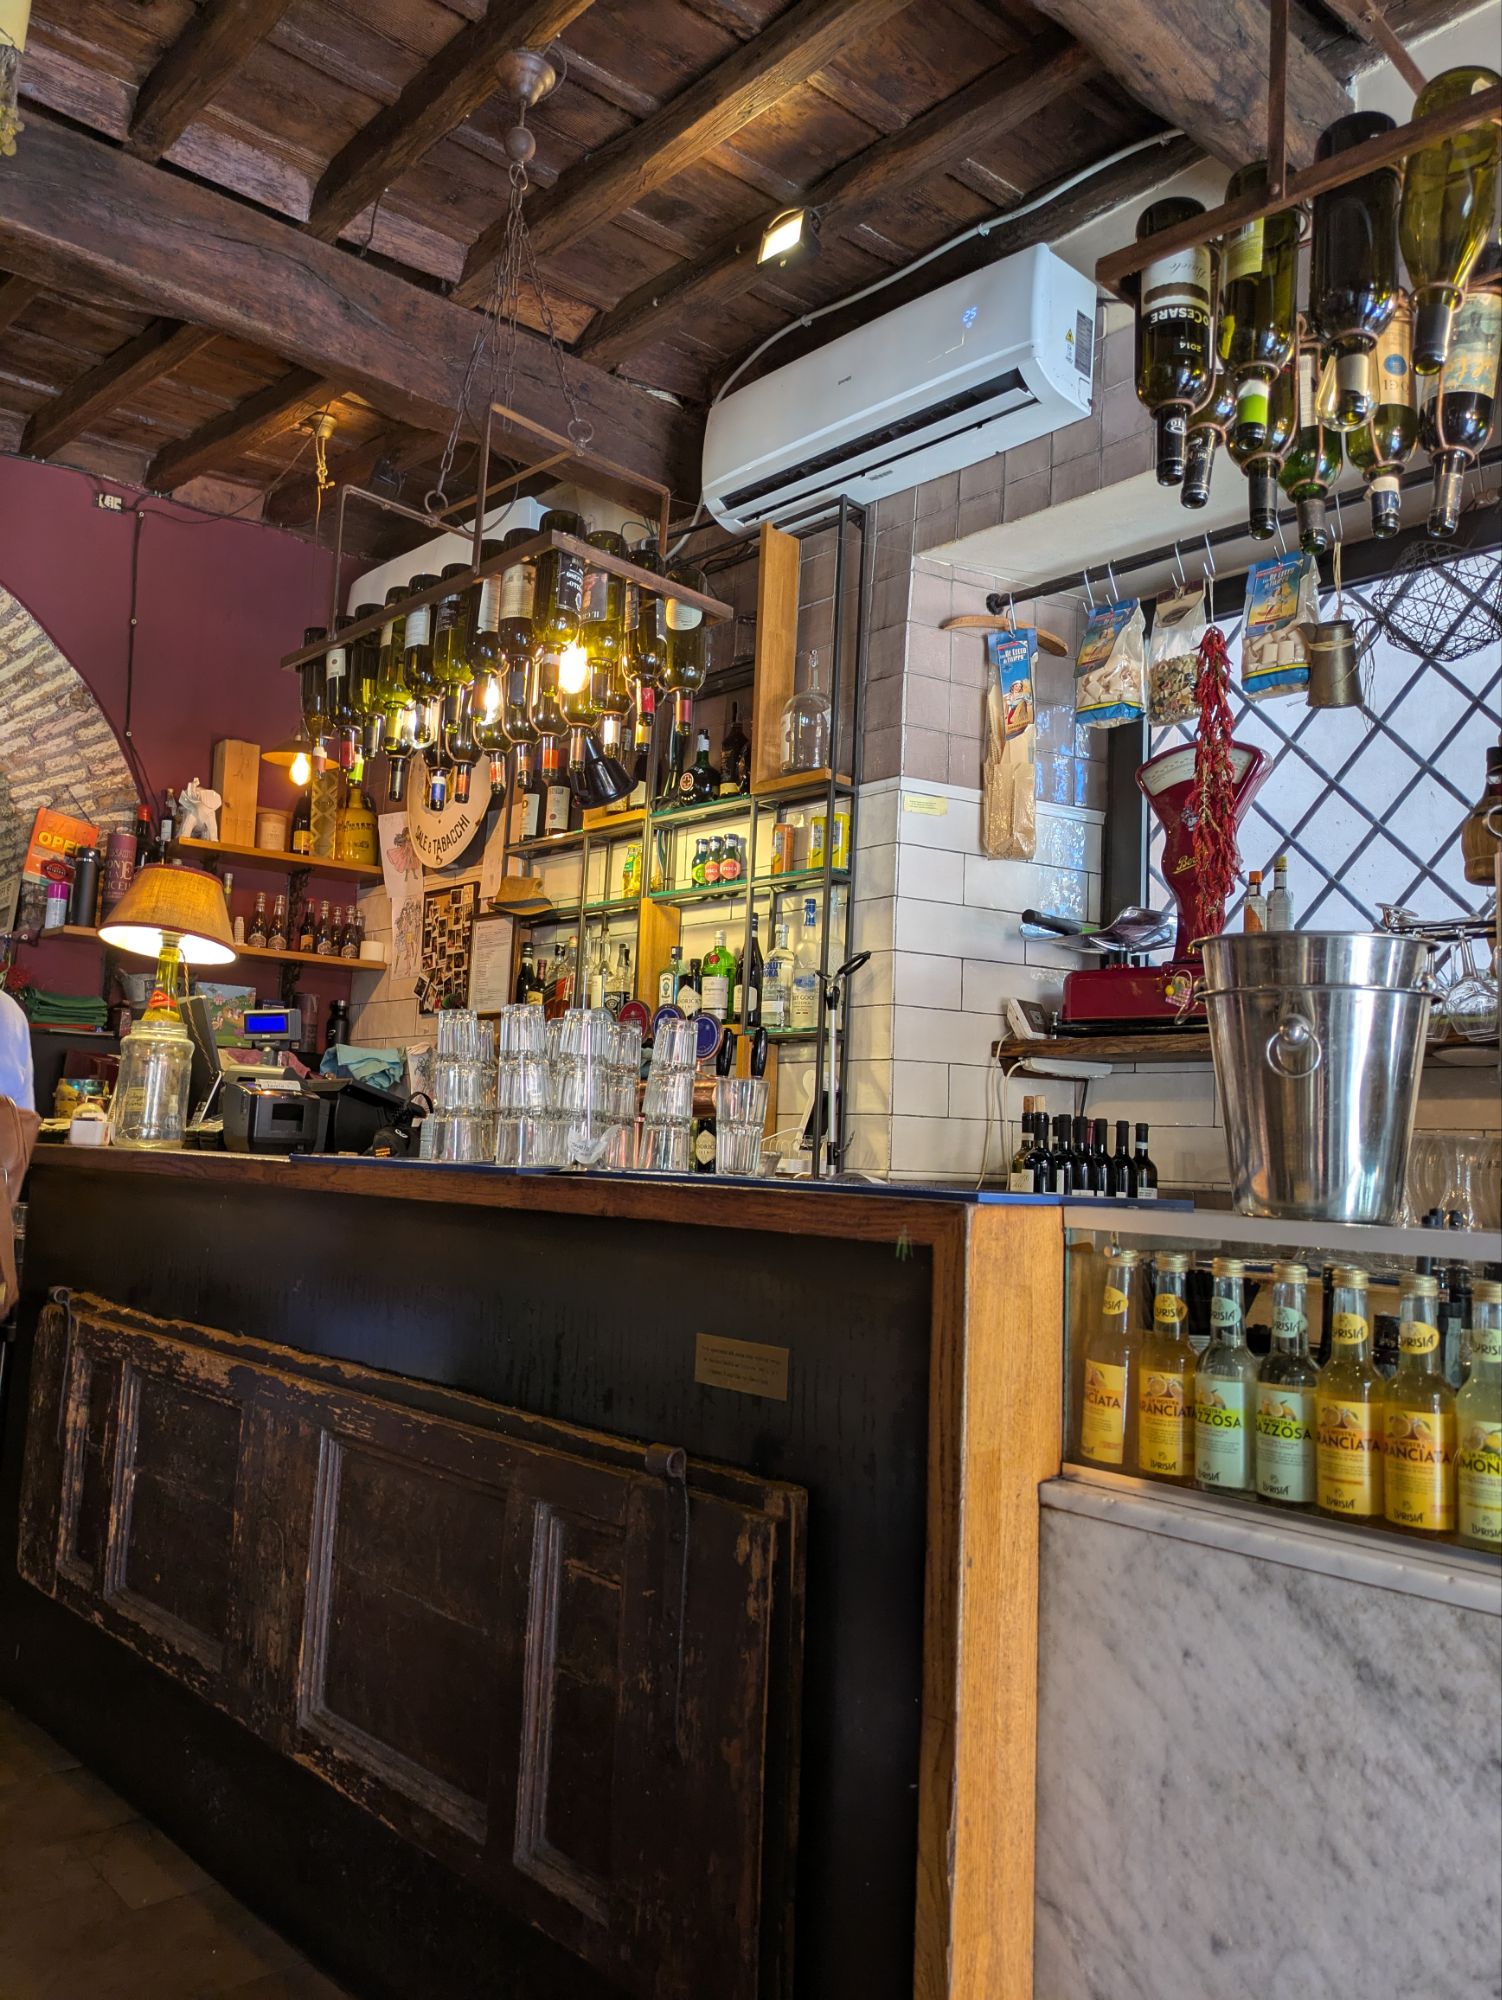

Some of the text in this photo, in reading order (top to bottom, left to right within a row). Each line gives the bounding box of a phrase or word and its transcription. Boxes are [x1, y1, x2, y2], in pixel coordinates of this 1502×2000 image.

[962, 306, 977, 321] 25
[1179, 340, 1202, 353] 2014
[37, 831, 82, 857] OPE
[432, 813, 471, 855] TABACCHI
